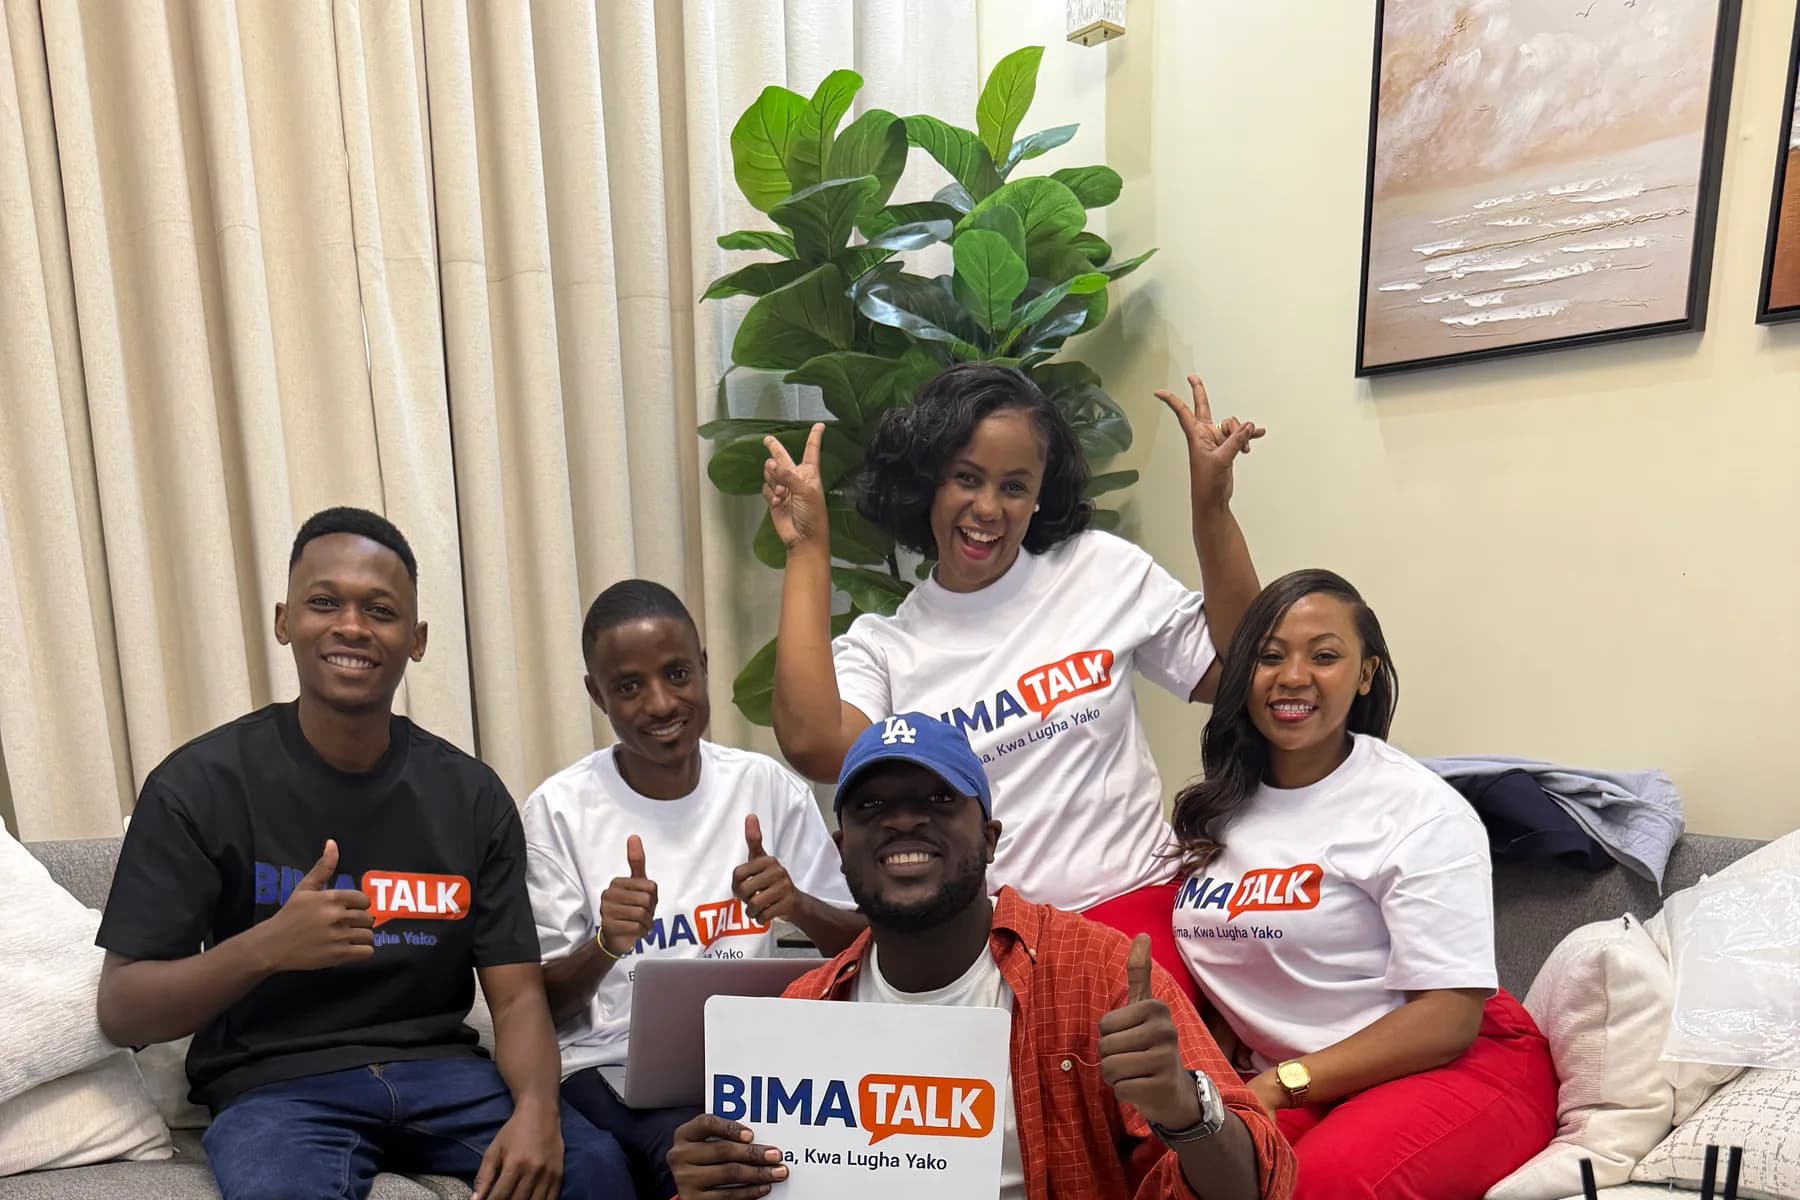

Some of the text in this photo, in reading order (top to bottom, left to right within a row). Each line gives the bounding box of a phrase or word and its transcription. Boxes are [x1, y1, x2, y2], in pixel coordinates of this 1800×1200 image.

[940, 653, 1108, 737] MA TALK
[882, 716, 917, 745] LA
[996, 708, 1101, 757] Kwa Lugha Yako
[370, 878, 461, 914] TALK
[1235, 870, 1313, 907] TALK
[373, 931, 437, 946] gha Yako
[1193, 926, 1215, 938] Kwa
[1216, 926, 1248, 941] Lugha
[1250, 926, 1283, 939] Yako
[715, 949, 744, 960] Yako
[712, 1073, 983, 1130] BIMA TALK
[804, 1148, 841, 1165] Kwa
[847, 1150, 900, 1171] Lugha
[905, 1153, 947, 1170] Yako
